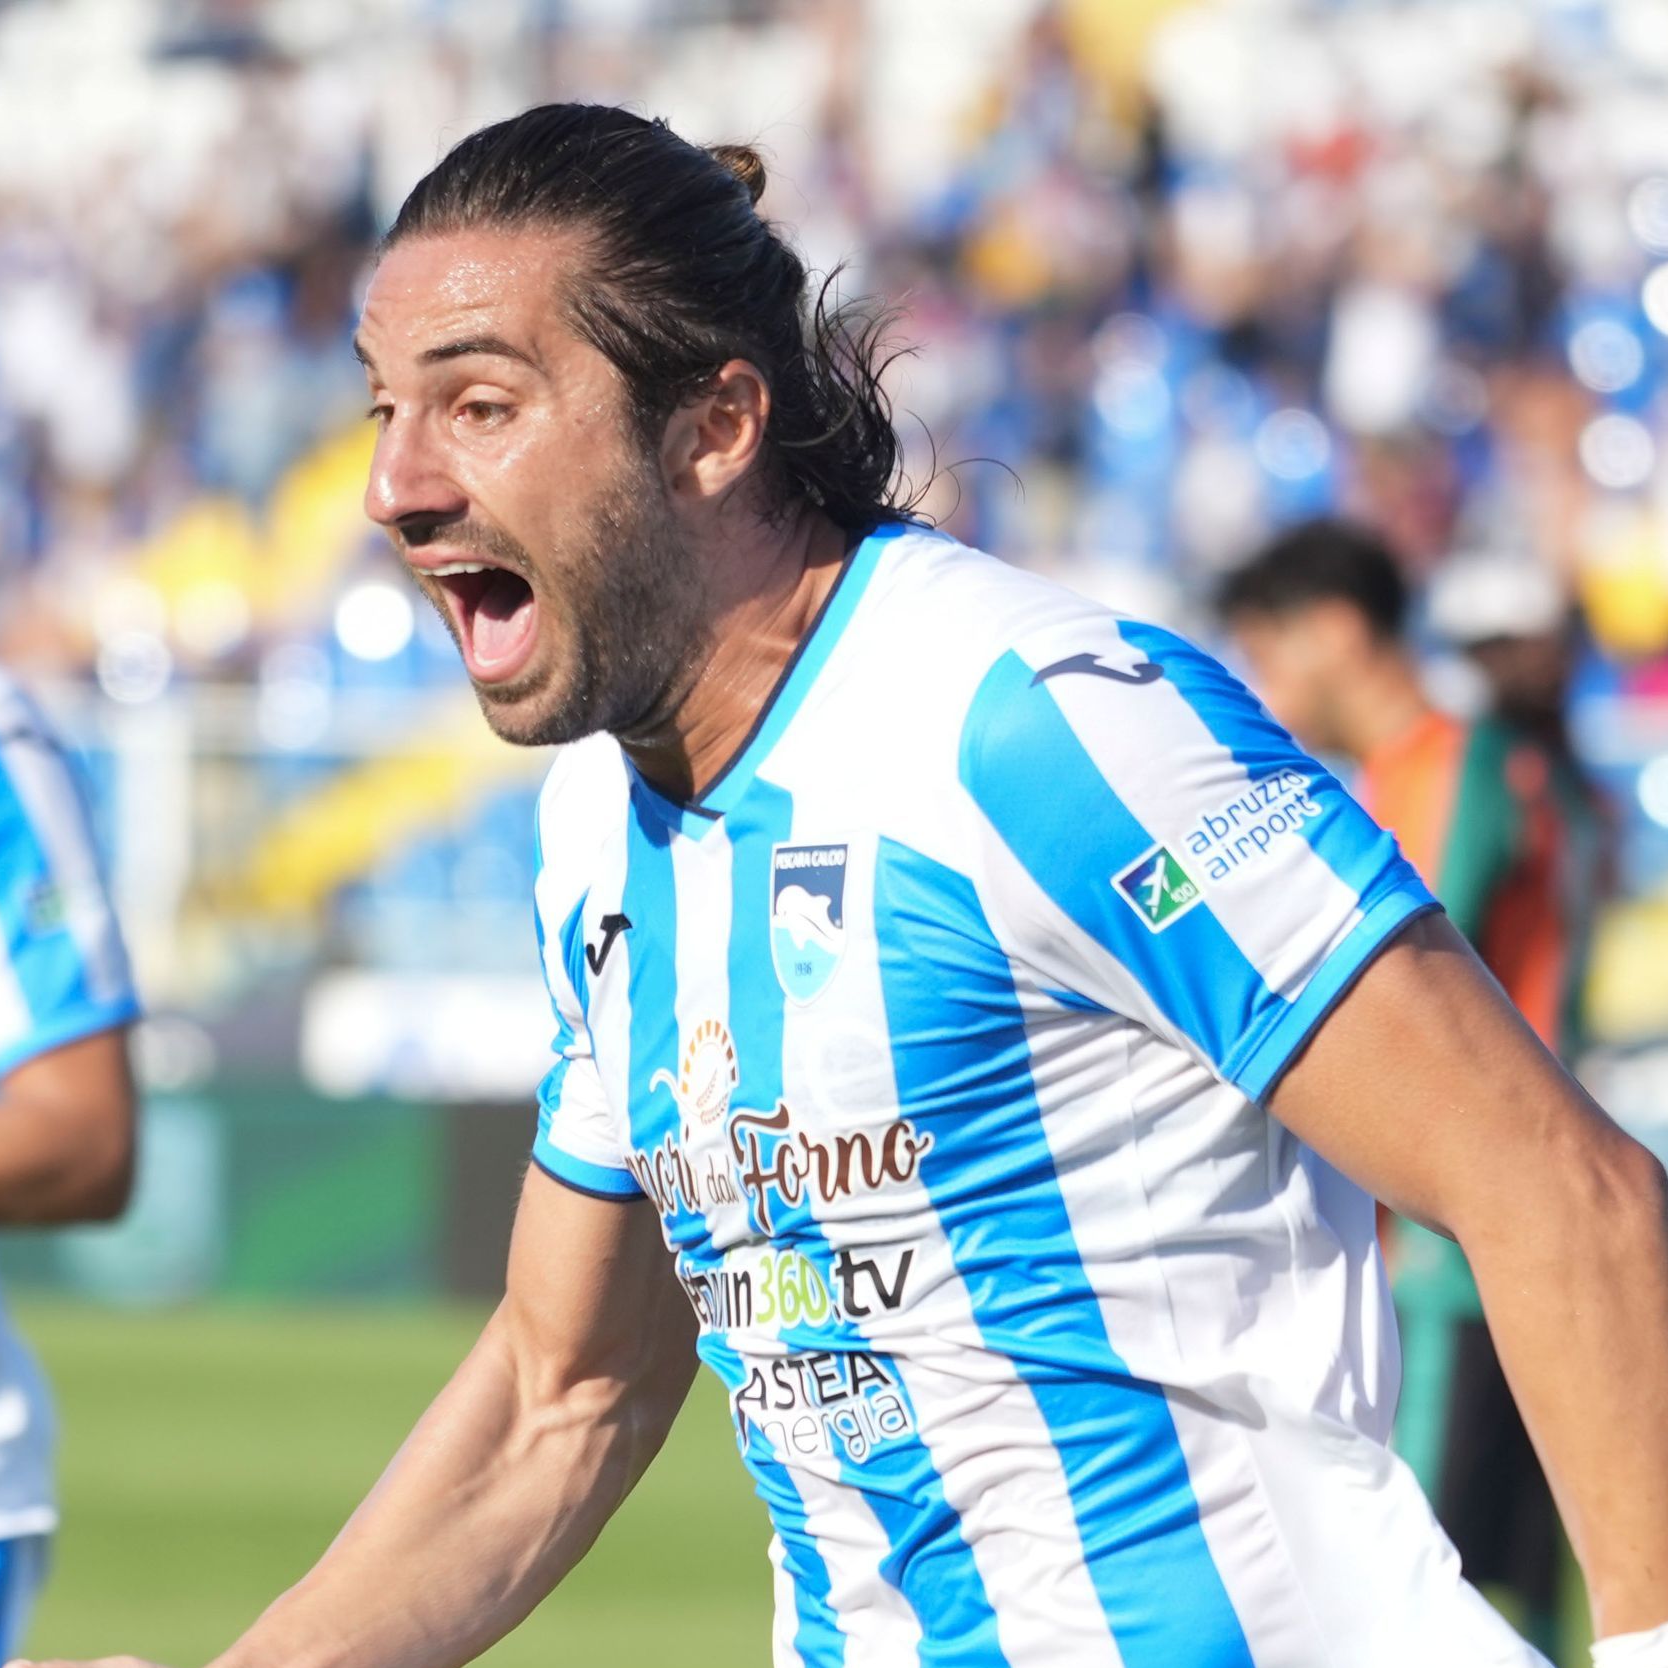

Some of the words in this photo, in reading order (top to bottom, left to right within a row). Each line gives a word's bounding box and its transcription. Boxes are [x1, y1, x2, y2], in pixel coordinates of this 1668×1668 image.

[1185, 770, 1304, 855] abruzzo
[1203, 793, 1316, 880] airport
[731, 1102, 930, 1235] Forno
[736, 1351, 891, 1446] ASTEA
